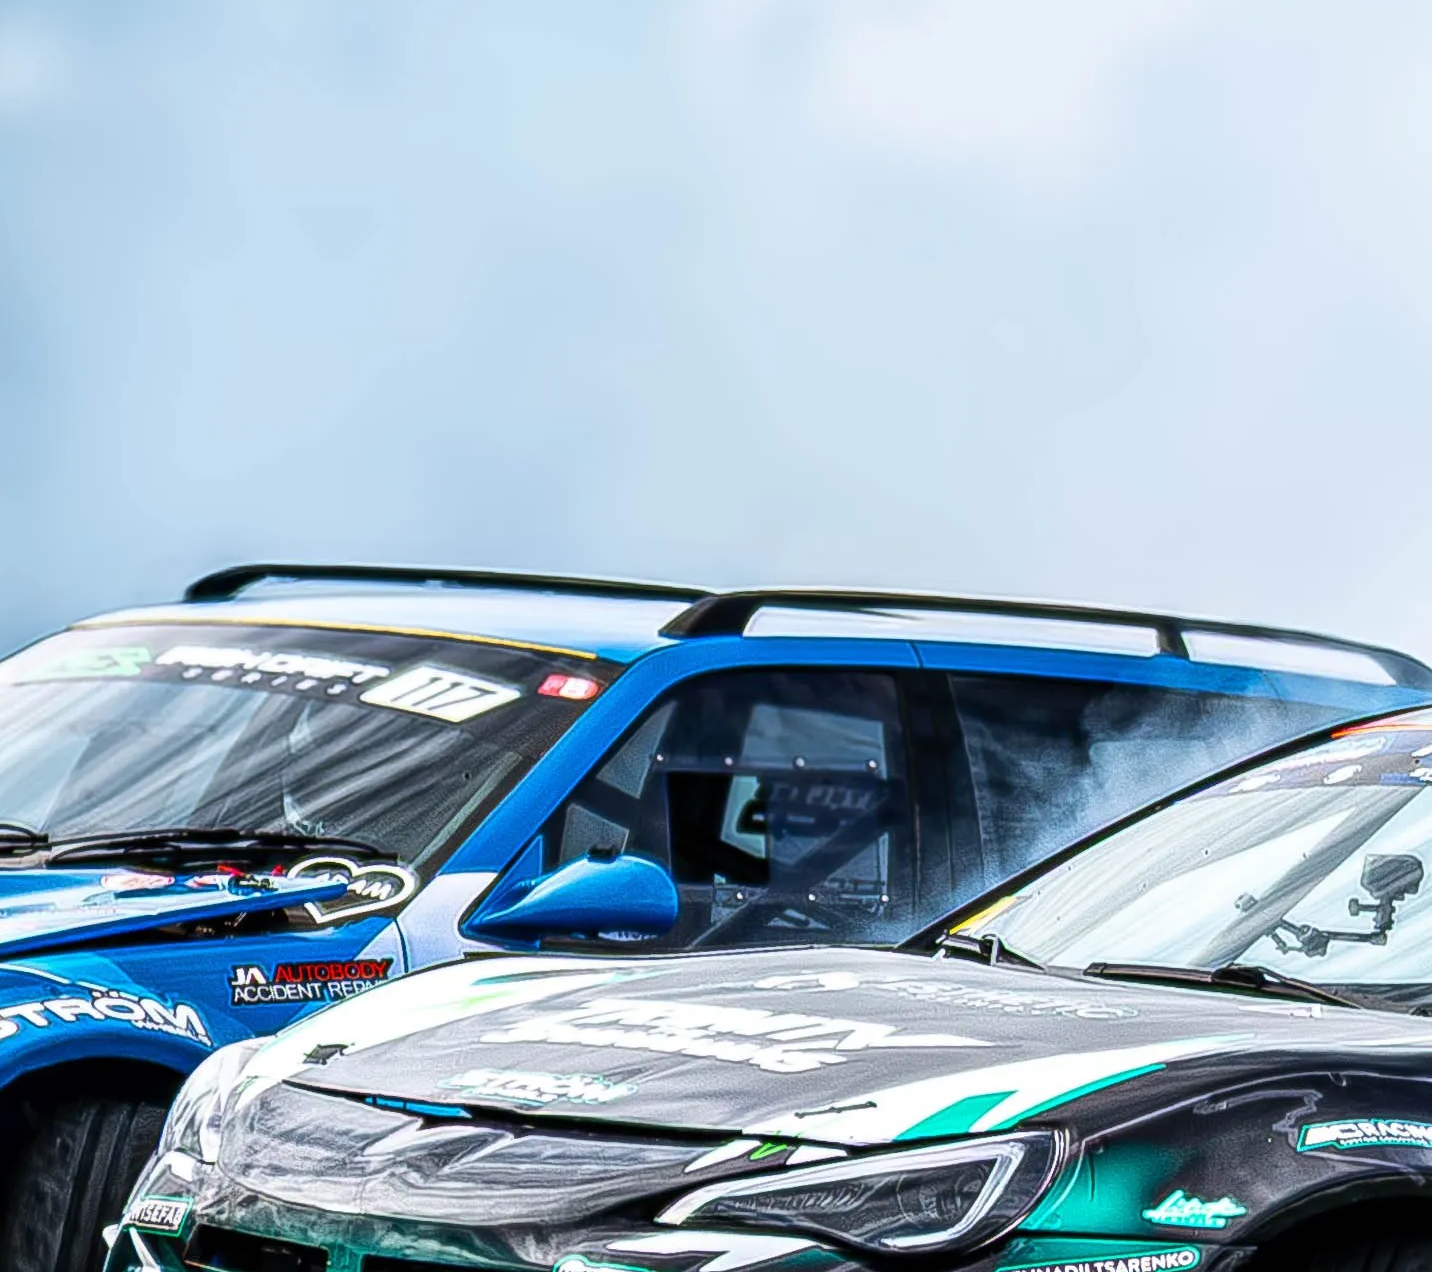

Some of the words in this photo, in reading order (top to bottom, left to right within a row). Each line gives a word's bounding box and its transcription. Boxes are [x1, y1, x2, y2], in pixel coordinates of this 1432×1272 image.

[389, 676, 493, 712] 117
[232, 967, 266, 985] JA
[275, 960, 387, 984] AUTOBODY
[234, 982, 322, 1003] ACCIDENT
